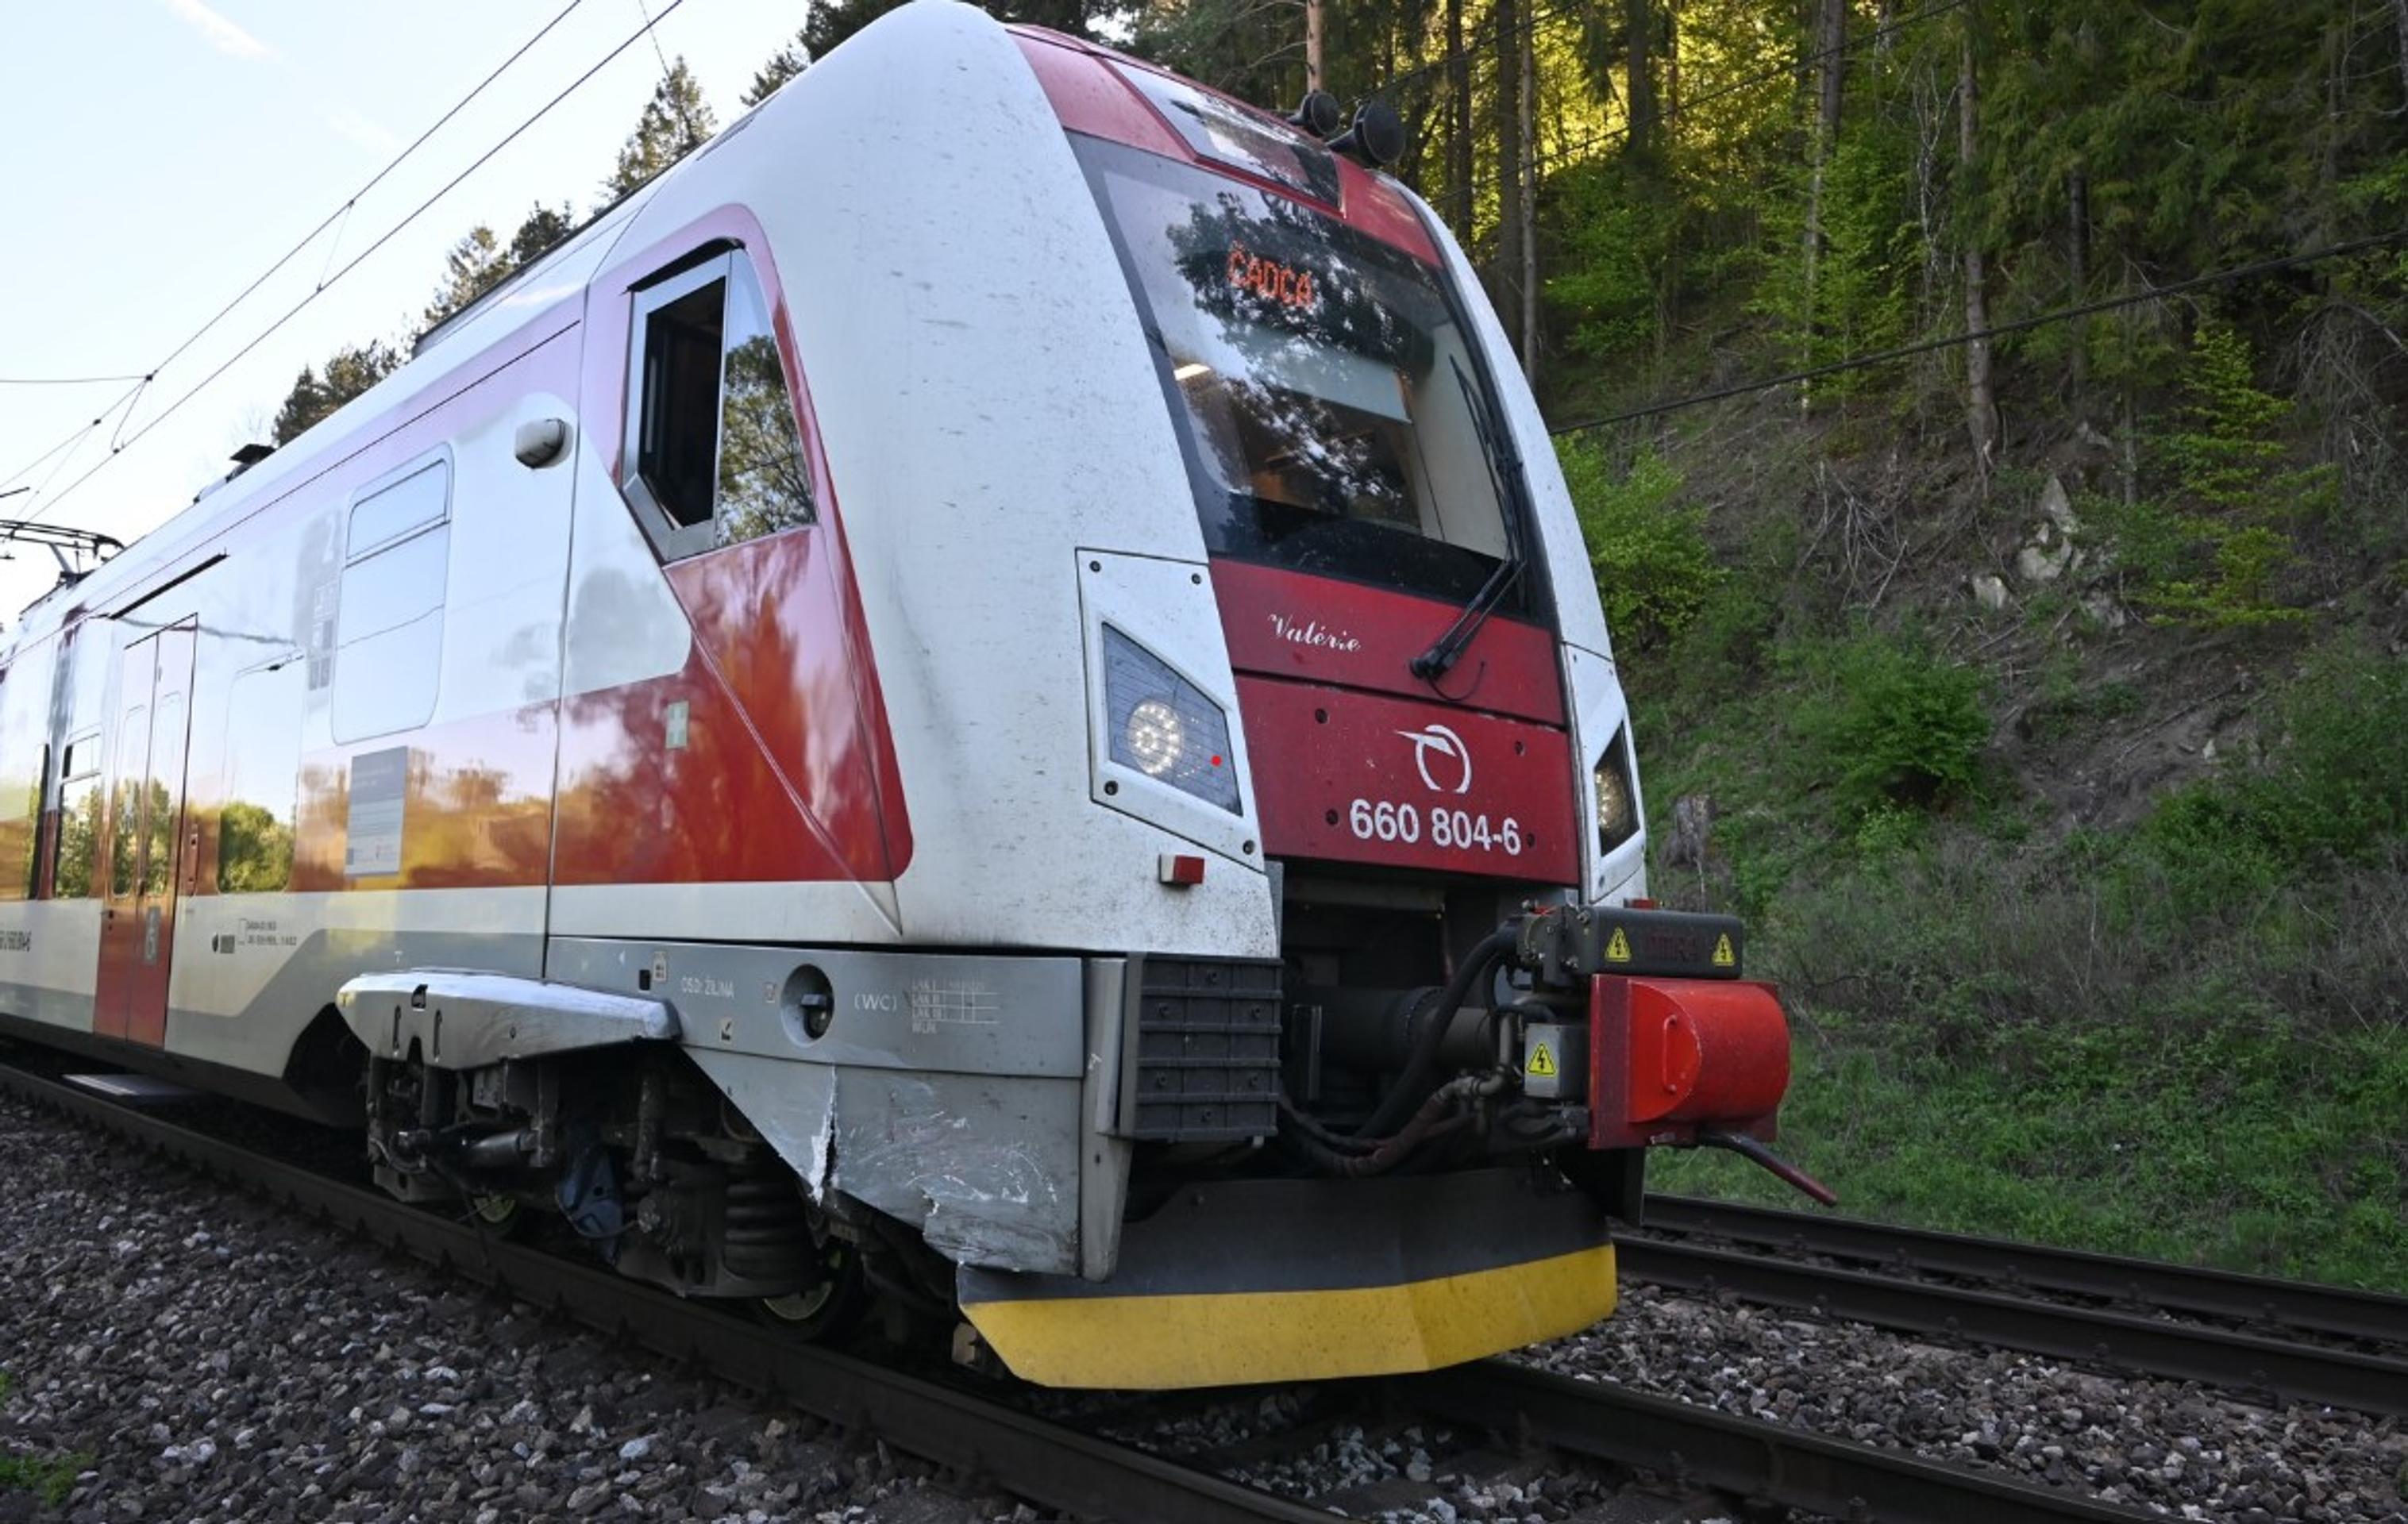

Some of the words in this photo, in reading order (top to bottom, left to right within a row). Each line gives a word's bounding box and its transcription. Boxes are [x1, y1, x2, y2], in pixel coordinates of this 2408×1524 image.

[1267, 614, 1362, 652] Valérie
[1349, 798, 1420, 844] 660
[1431, 806, 1522, 856] 804-6
[854, 992, 897, 1012] (WC)
